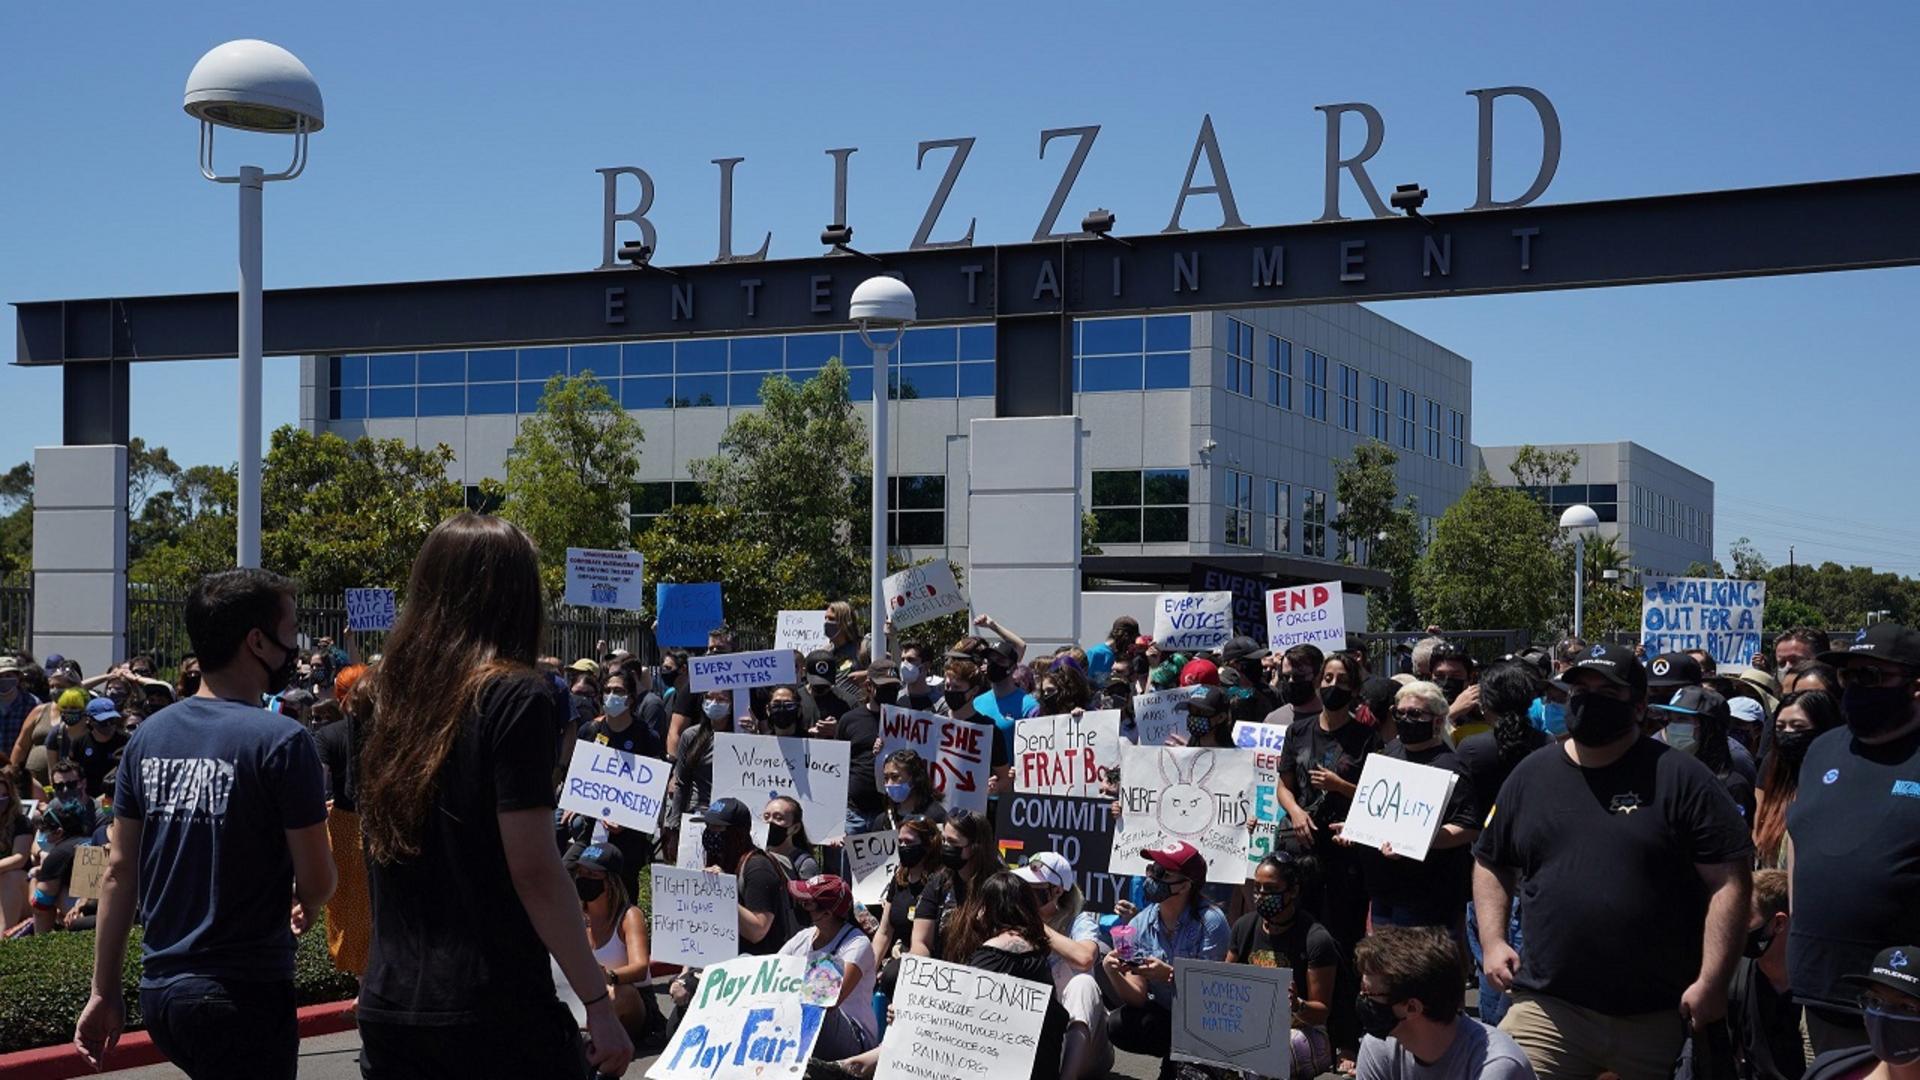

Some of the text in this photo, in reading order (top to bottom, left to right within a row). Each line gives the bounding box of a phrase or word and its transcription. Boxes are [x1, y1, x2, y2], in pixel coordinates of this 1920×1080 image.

[595, 85, 1562, 271] BLIZZARD
[604, 227, 1541, 325] ENTETAINMENT
[347, 590, 393, 604] EVERY
[348, 602, 393, 616] VOICE
[1164, 597, 1204, 613] EVERY
[1272, 585, 1330, 614] END
[350, 614, 394, 629] MATTERS
[1171, 611, 1225, 630] VOICE
[1276, 609, 1328, 628] FORCED
[1645, 606, 1754, 632] OUT FOR A
[1271, 626, 1344, 648] ARBITRATION
[694, 656, 777, 676] EVERY VOICE
[714, 670, 772, 686] MATTERS
[882, 706, 984, 755] WHAT SHE
[1016, 717, 1097, 756] Send the
[591, 754, 654, 785] LEAD
[742, 770, 793, 788] Matter
[1022, 749, 1078, 789] FRAT
[569, 777, 661, 819] RESPONSIBLY
[1121, 785, 1250, 828] NERF THIS
[1010, 797, 1112, 833] COMMIT
[852, 836, 896, 861] EQU
[1047, 833, 1081, 866] TO
[654, 875, 690, 896] FIGHT
[653, 914, 736, 941] FIGHT BAD GUYS
[680, 937, 705, 955] IRL
[699, 958, 804, 1009] Play Nice
[900, 957, 1047, 1014] PLEASE DONATE
[1203, 1000, 1243, 1019] VOICES
[1202, 1016, 1244, 1034] MATTER
[666, 1003, 827, 1079] Play Fair!
